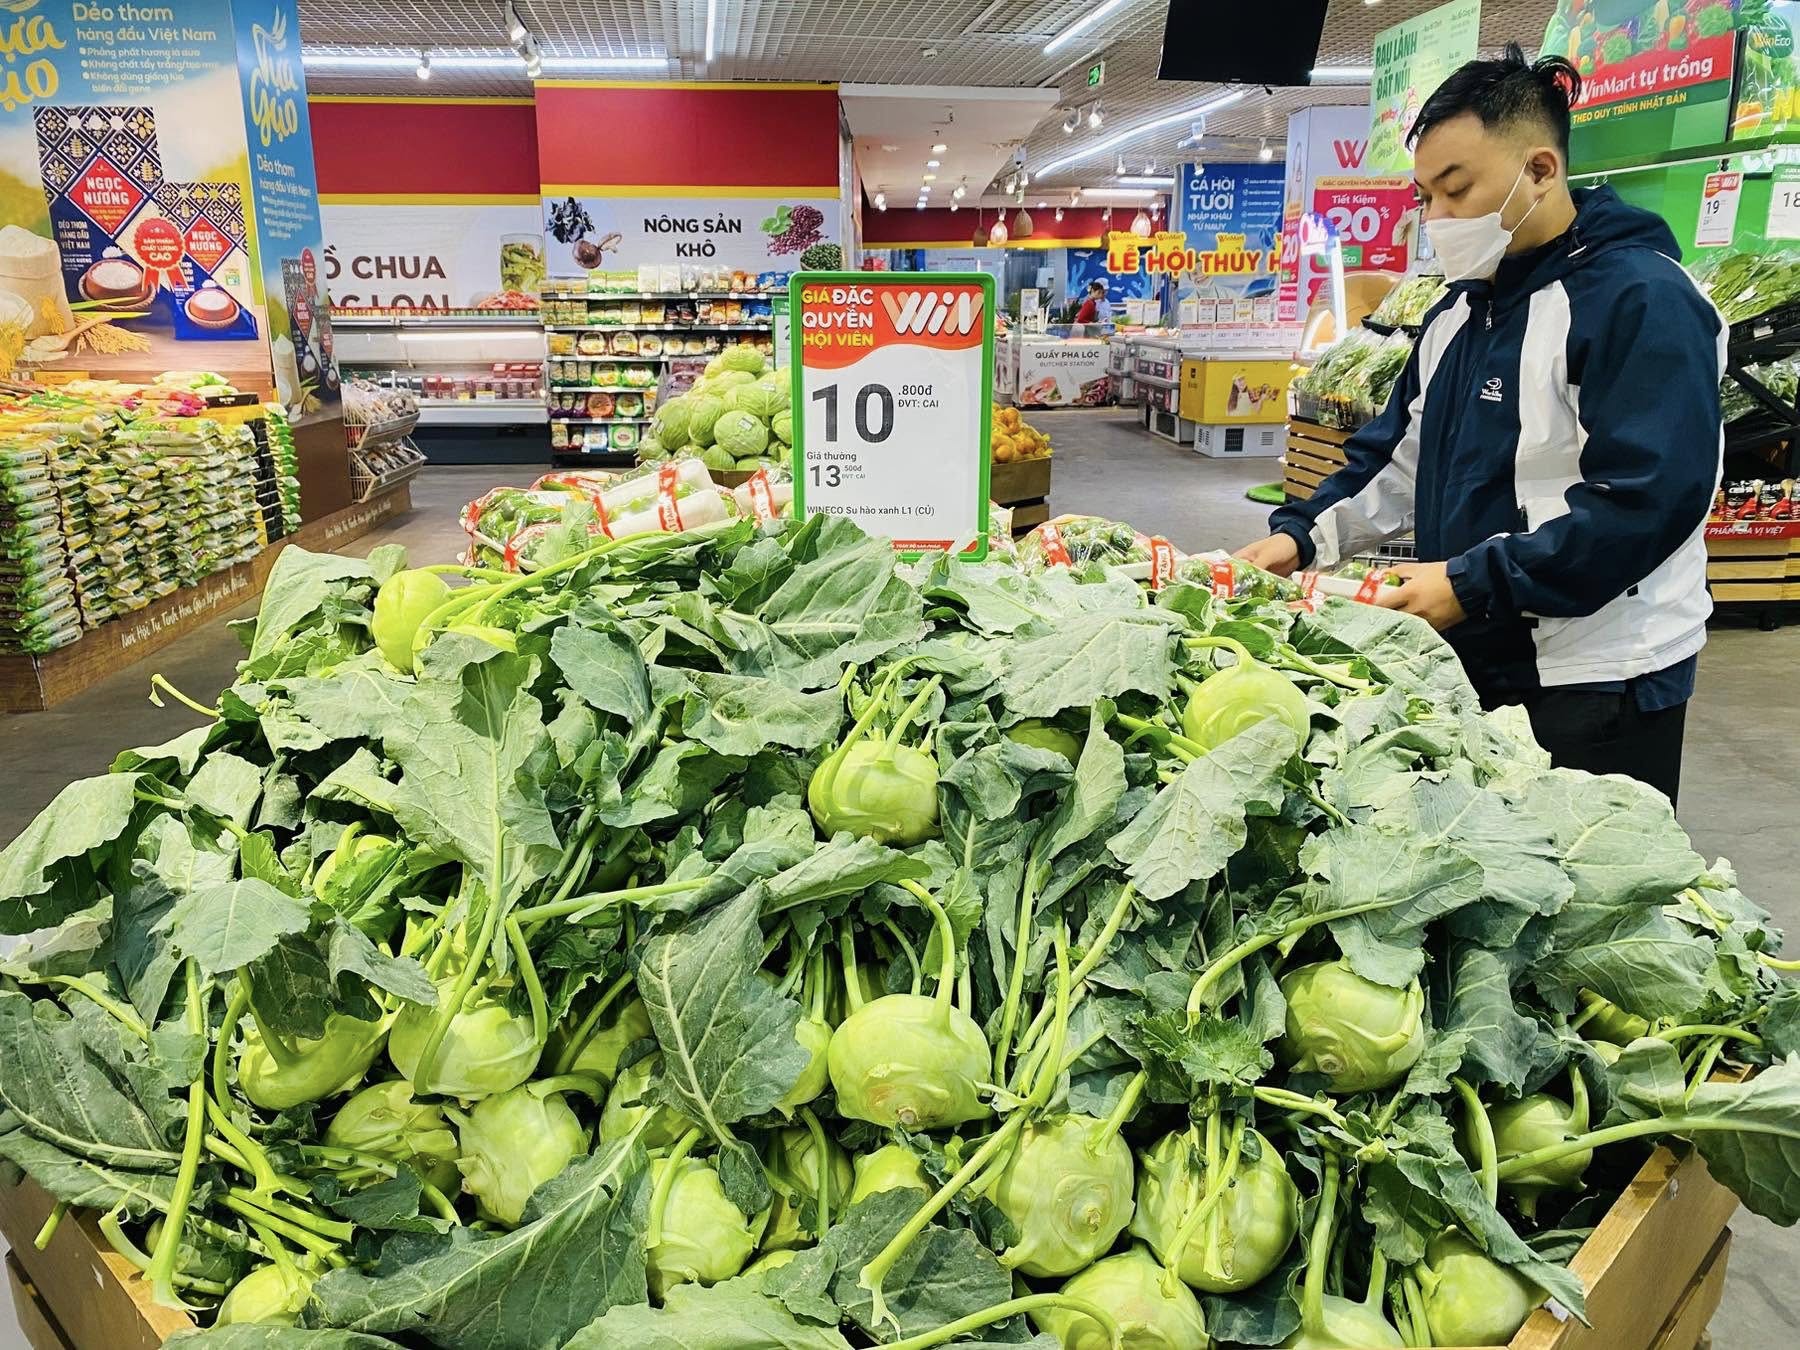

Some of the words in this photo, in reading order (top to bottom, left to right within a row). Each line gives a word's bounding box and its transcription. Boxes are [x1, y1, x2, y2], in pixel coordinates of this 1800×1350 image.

[73, 0, 114, 21] Dẻo
[118, 3, 173, 21] thơm
[76, 27, 114, 45] hàng
[117, 26, 145, 41] đầu
[148, 28, 179, 44] Việt
[182, 28, 216, 41] Nam
[1375, 41, 1393, 69] RAU
[1393, 28, 1418, 61] LÀNH
[1640, 68, 1659, 90] tự
[1663, 55, 1714, 82] trồng
[1573, 113, 1593, 124] THEO
[1594, 108, 1611, 119] QUY
[1612, 102, 1638, 116] TRÌNH
[1639, 97, 1664, 111] NHẬT
[1666, 89, 1687, 104] BẢN
[86, 177, 123, 192] NGỌC
[1190, 176, 1209, 191] CÁ
[1211, 175, 1235, 191] HỒI
[1189, 191, 1234, 211] TƯƠI
[1331, 193, 1351, 203] Tiết
[1352, 194, 1377, 205] Kiệm
[1705, 200, 1720, 214] 19
[643, 215, 699, 233] NÔNG
[703, 212, 742, 233] SẢN
[149, 252, 172, 261] CAO
[676, 239, 716, 257] KHÔ
[351, 255, 447, 279] CHUA
[1109, 244, 1138, 272] LỄ
[1147, 246, 1194, 276] HỘI
[1201, 246, 1261, 273] THỦY
[801, 286, 831, 304] GIÁ
[832, 285, 874, 307] ĐẶC
[802, 307, 873, 329] QUYỀN
[803, 331, 832, 349] HỘI
[836, 331, 874, 347] VIÊN
[812, 383, 895, 443] 10
[807, 451, 822, 460] Giá
[824, 451, 857, 463] thường
[809, 465, 841, 487] 13
[807, 506, 844, 514] WINECO
[846, 506, 857, 514] Su
[860, 506, 876, 514] hào
[878, 506, 899, 514] xanh
[902, 507, 912, 515] L1
[915, 505, 935, 516] (CỦ)
[1755, 527, 1764, 536] VỊ
[1765, 526, 1785, 535] VIỆT
